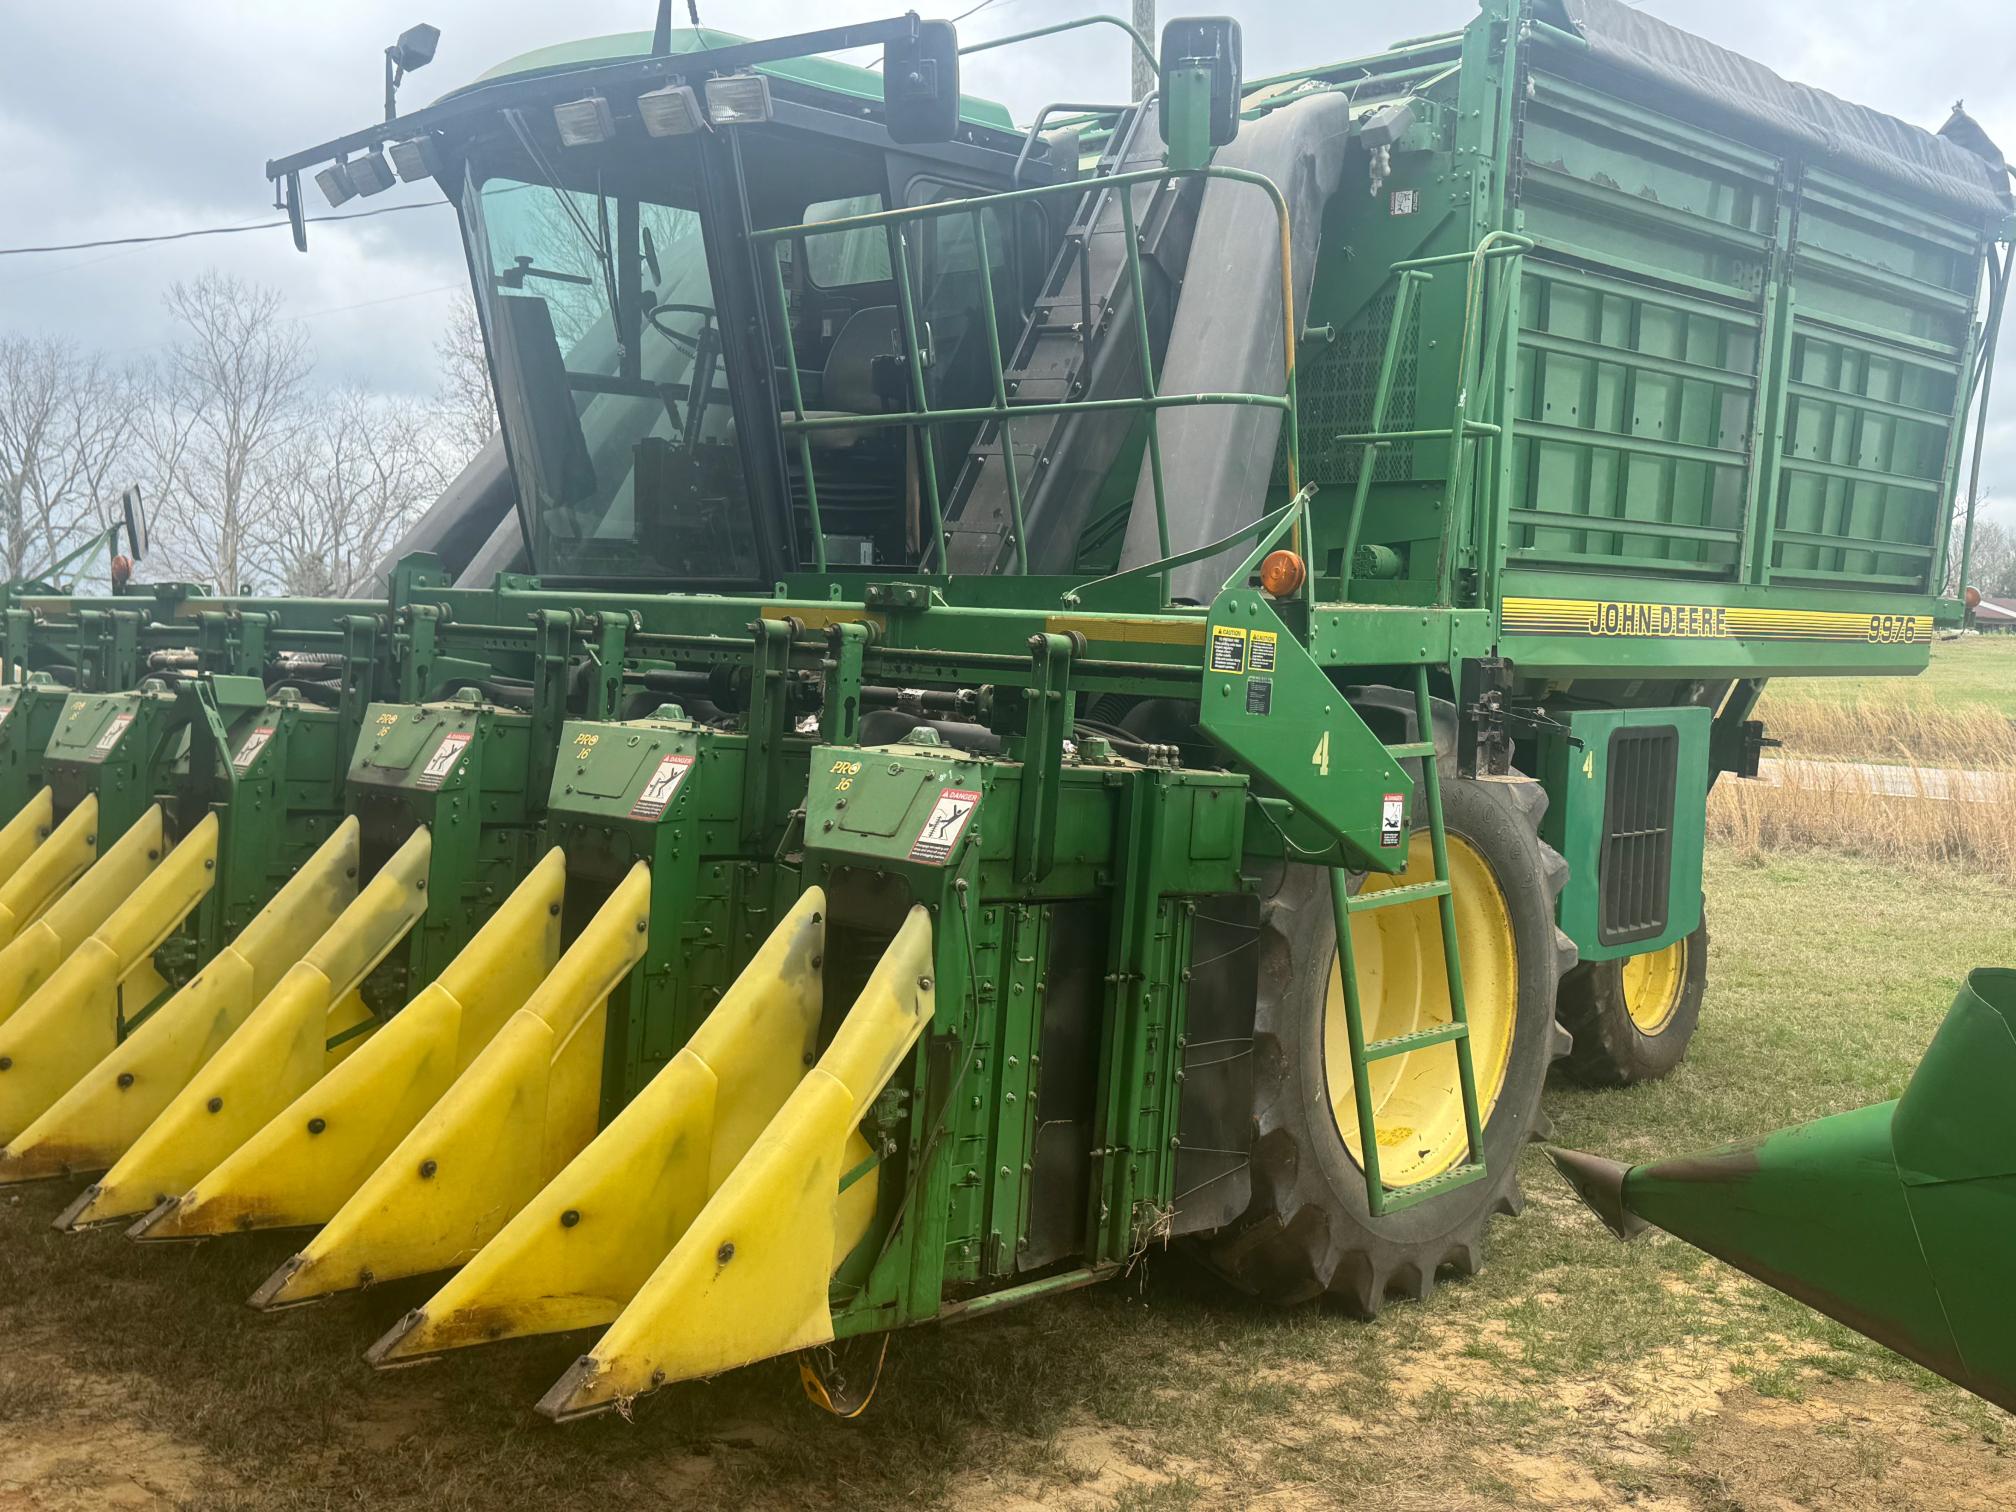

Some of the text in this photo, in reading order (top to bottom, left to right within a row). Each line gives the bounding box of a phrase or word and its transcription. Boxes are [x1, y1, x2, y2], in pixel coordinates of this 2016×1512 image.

[1588, 602, 1727, 638] JOHN DEERE
[1222, 628, 1242, 636] CAUTION
[1868, 615, 1916, 643] 9976
[1256, 634, 1275, 642] CAUTION
[375, 712, 399, 725] PRO
[376, 726, 391, 737] 16
[573, 732, 599, 745] PRO
[576, 748, 592, 760] 16
[668, 755, 693, 764] DANGER
[1311, 730, 1330, 776] 4
[829, 760, 862, 776] PRO
[1582, 750, 1593, 779] 4
[834, 777, 854, 792] 16
[948, 791, 978, 801] DANGER
